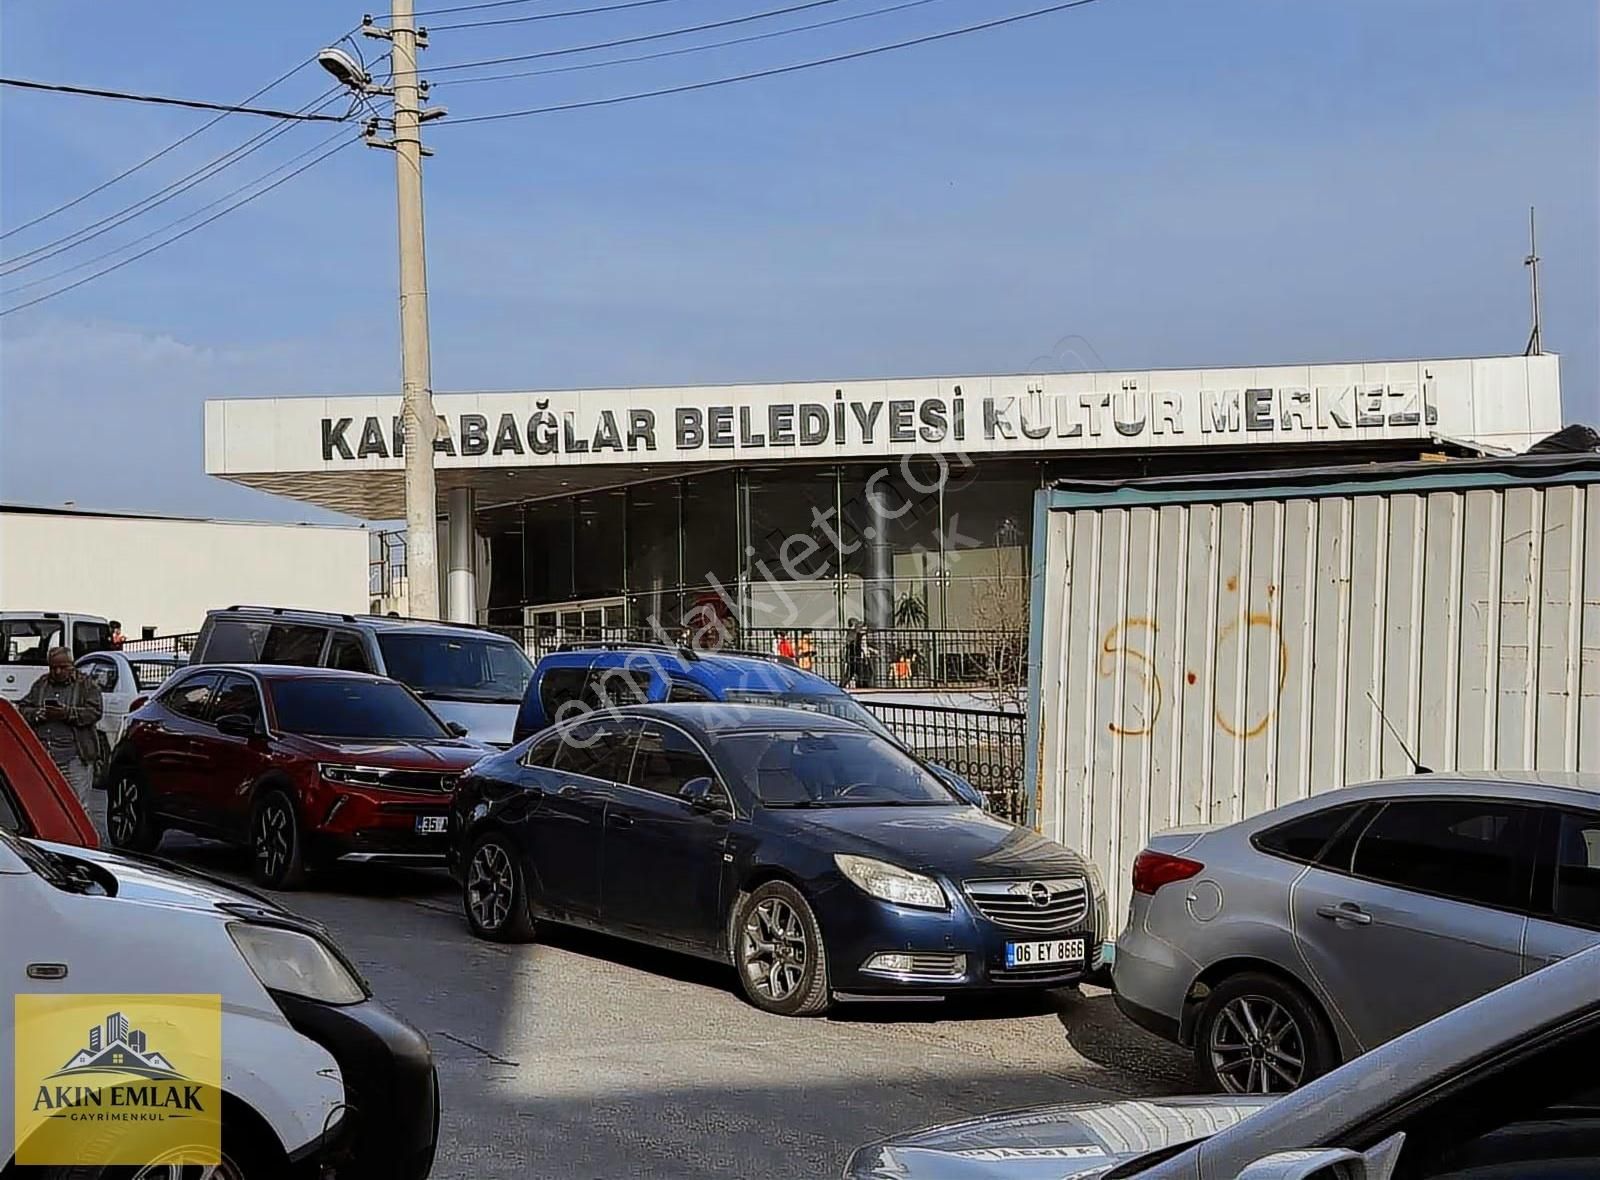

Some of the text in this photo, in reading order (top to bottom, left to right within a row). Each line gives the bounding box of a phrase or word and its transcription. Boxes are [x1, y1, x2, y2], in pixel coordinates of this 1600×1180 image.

[675, 387, 965, 449] BELEDİYESİ
[983, 379, 1184, 440] KÜLTÜR
[1199, 368, 1438, 434] MERKEZİ
[1016, 945, 1030, 962] 06
[1038, 943, 1051, 961] EY
